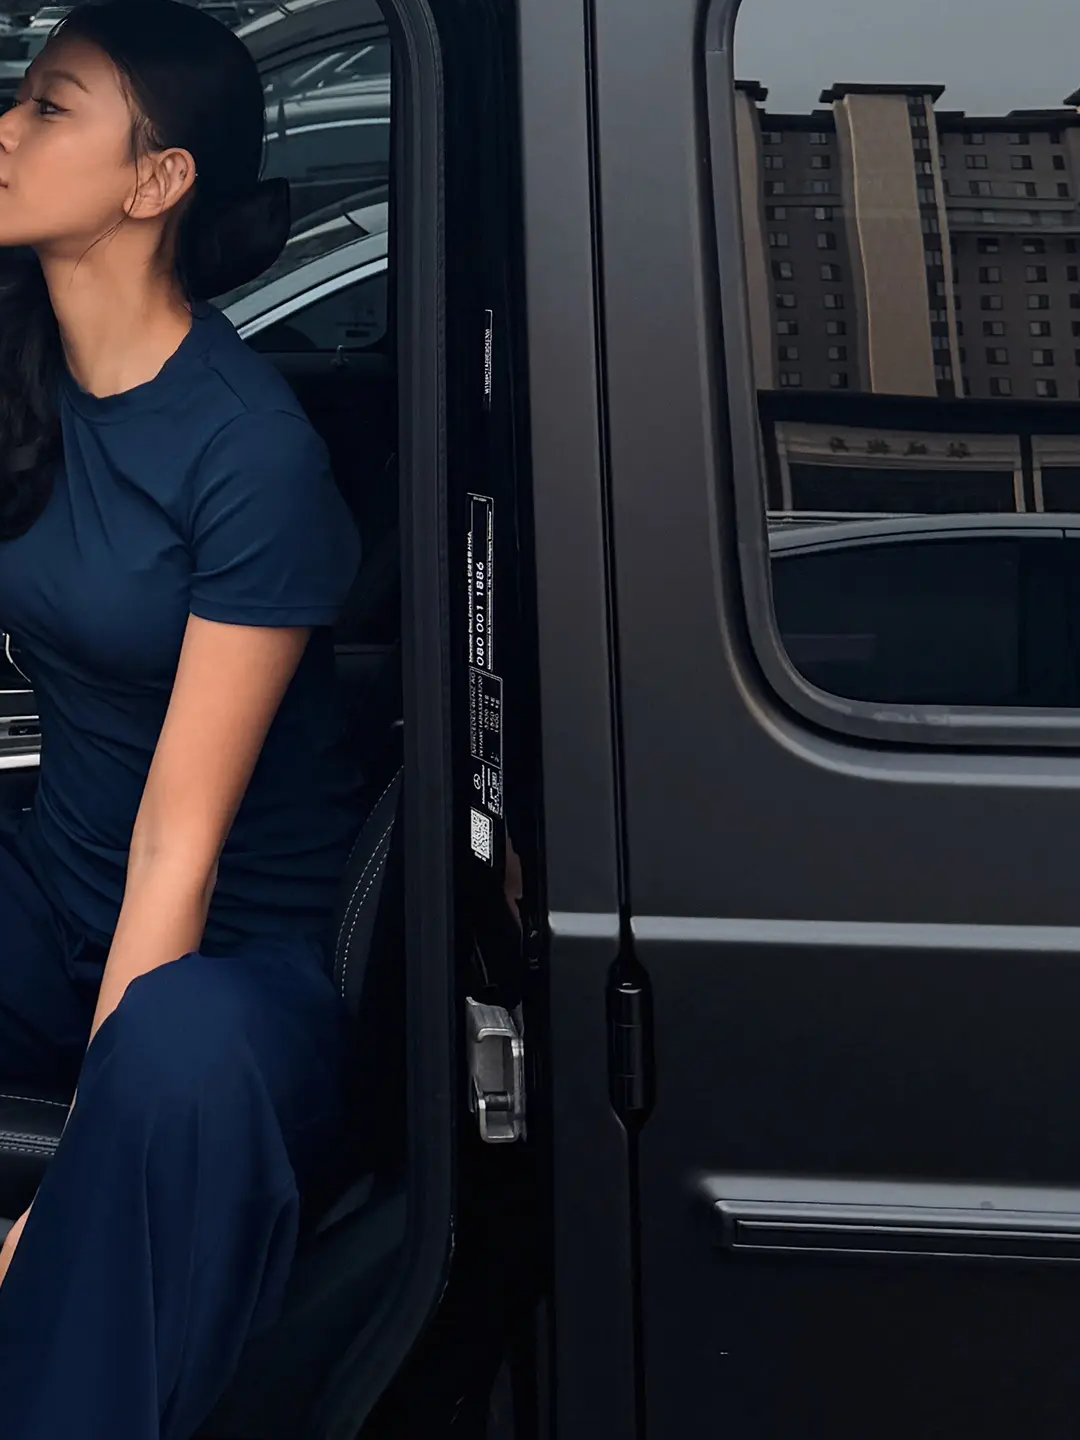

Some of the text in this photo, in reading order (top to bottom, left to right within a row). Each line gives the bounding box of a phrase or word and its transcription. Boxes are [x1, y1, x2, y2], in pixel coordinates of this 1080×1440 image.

[476, 561, 484, 596] 1886
[476, 605, 484, 633] 001
[476, 637, 484, 666] 080
